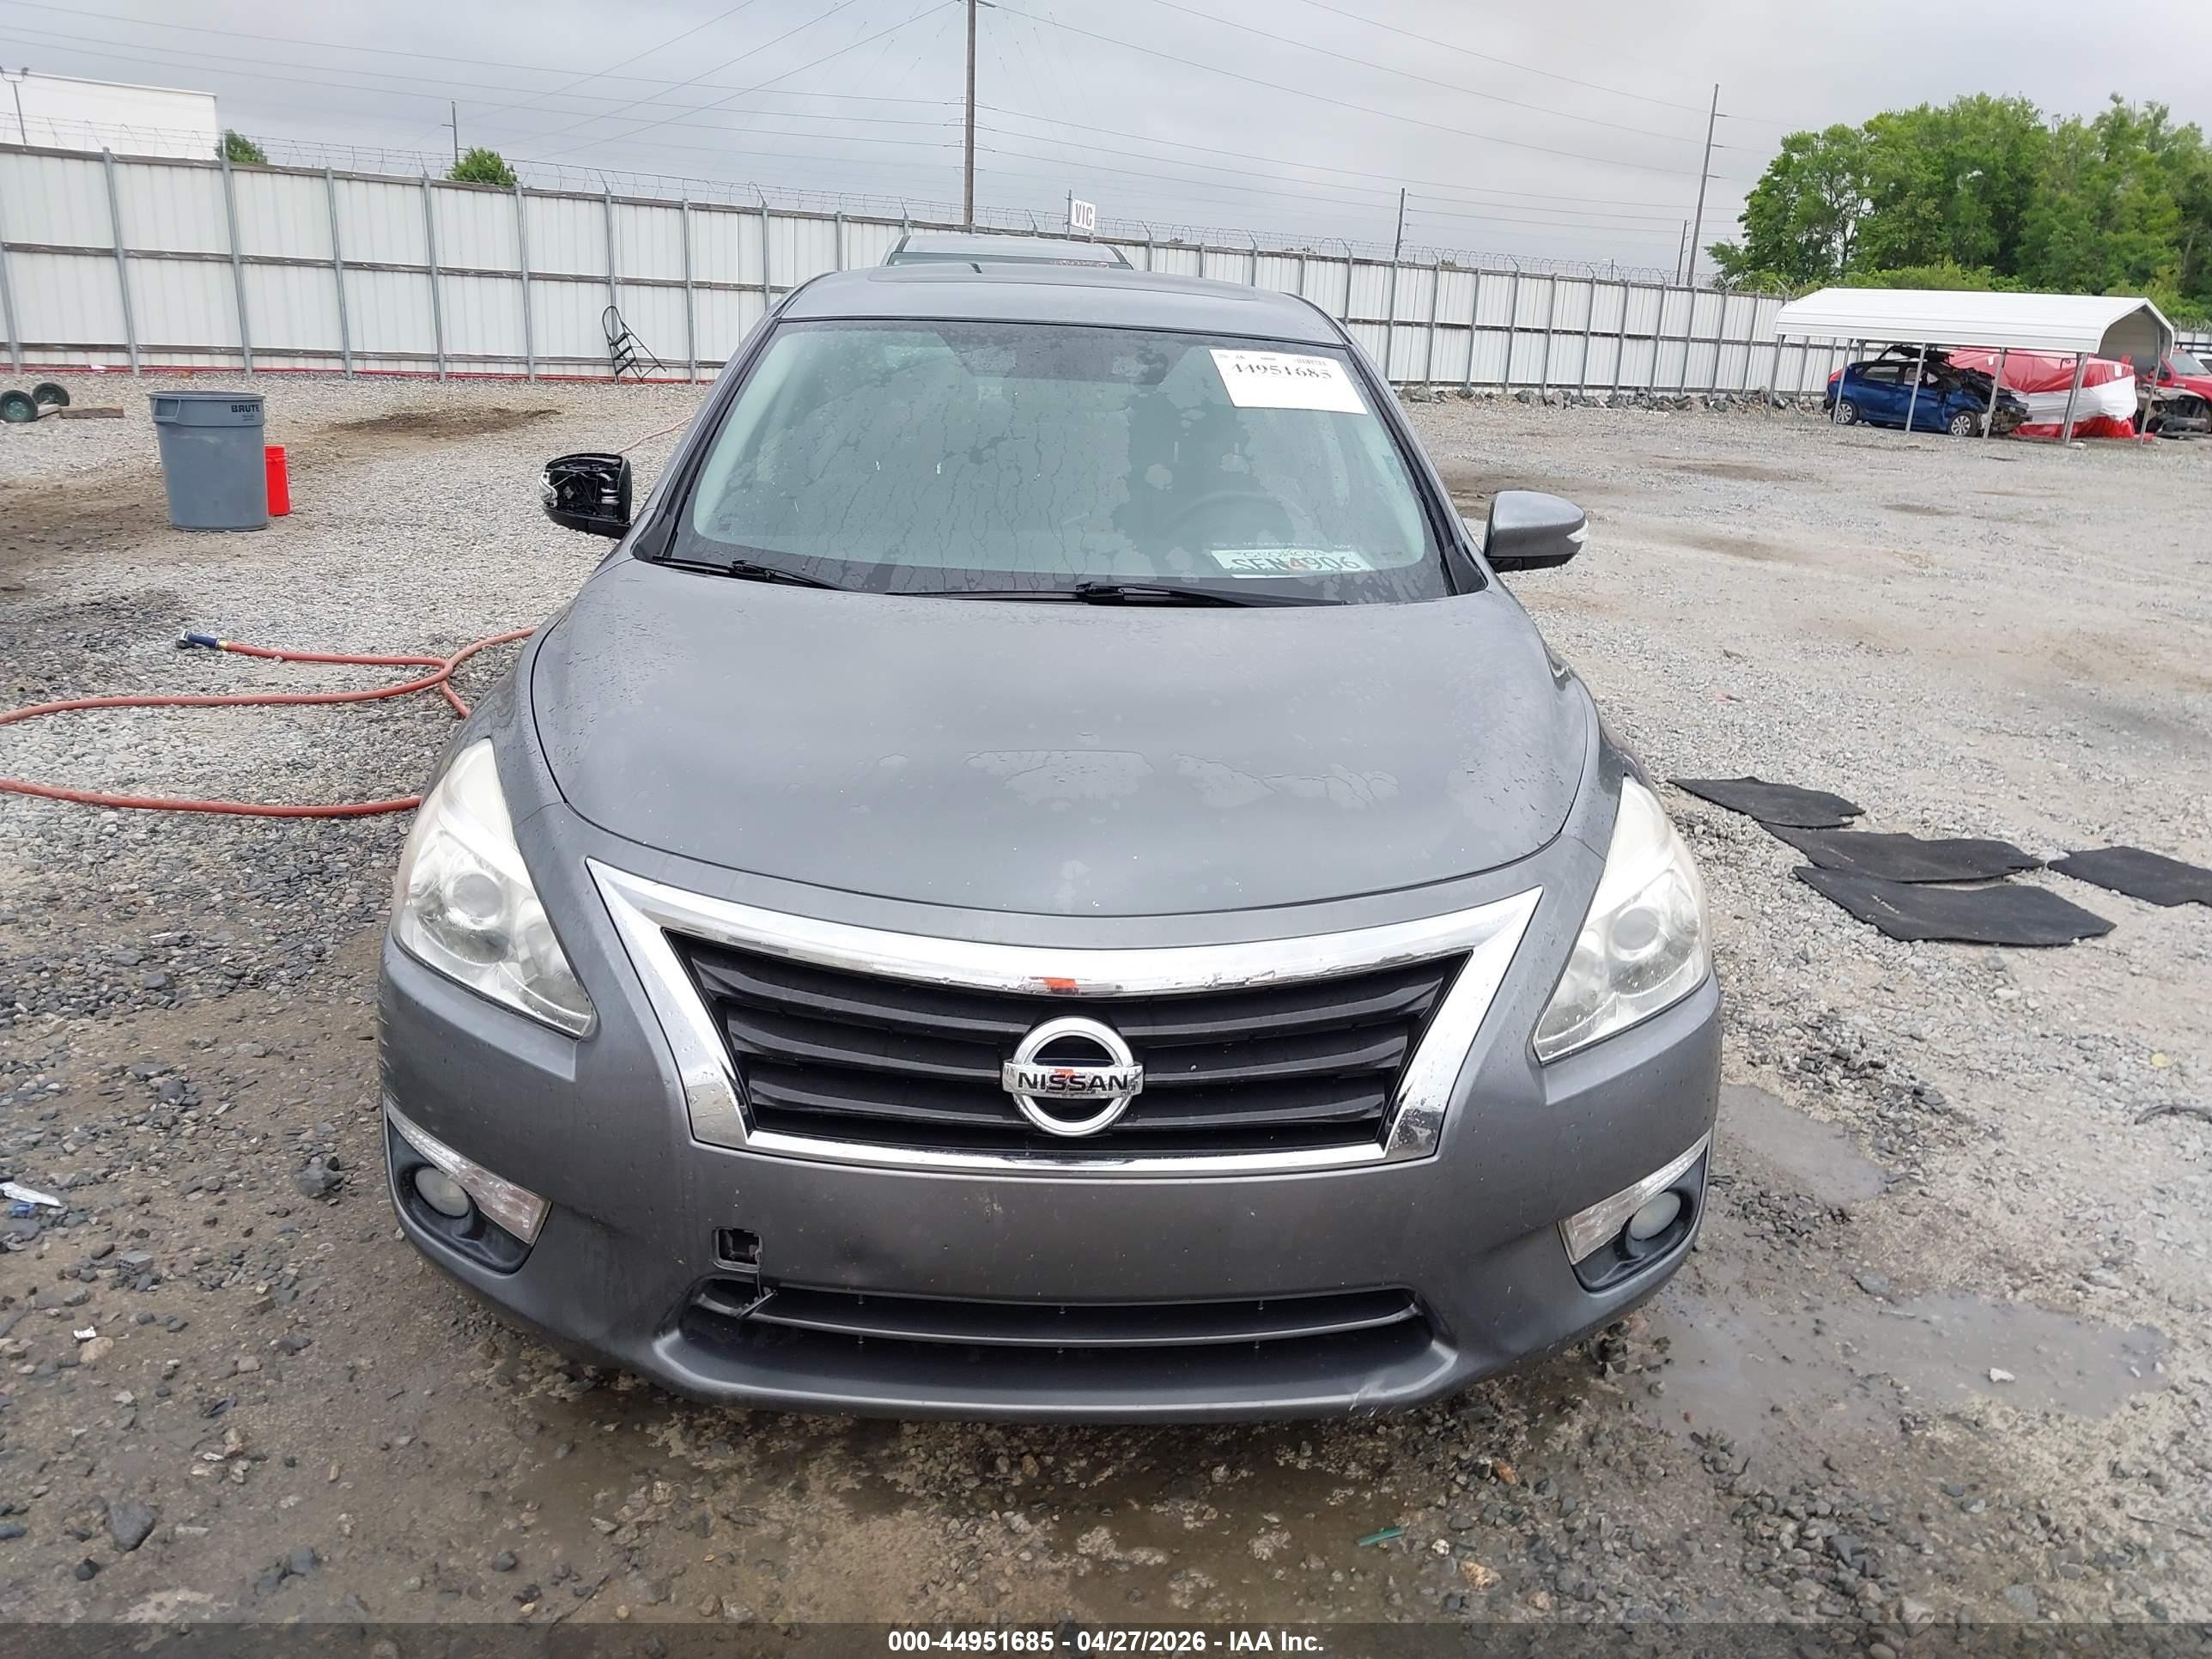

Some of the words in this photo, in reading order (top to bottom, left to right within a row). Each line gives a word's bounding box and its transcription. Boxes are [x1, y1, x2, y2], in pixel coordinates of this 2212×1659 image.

[1075, 204, 1093, 227] VIC
[231, 404, 260, 413] BRUTE
[1018, 1072, 1127, 1091] NISSAN
